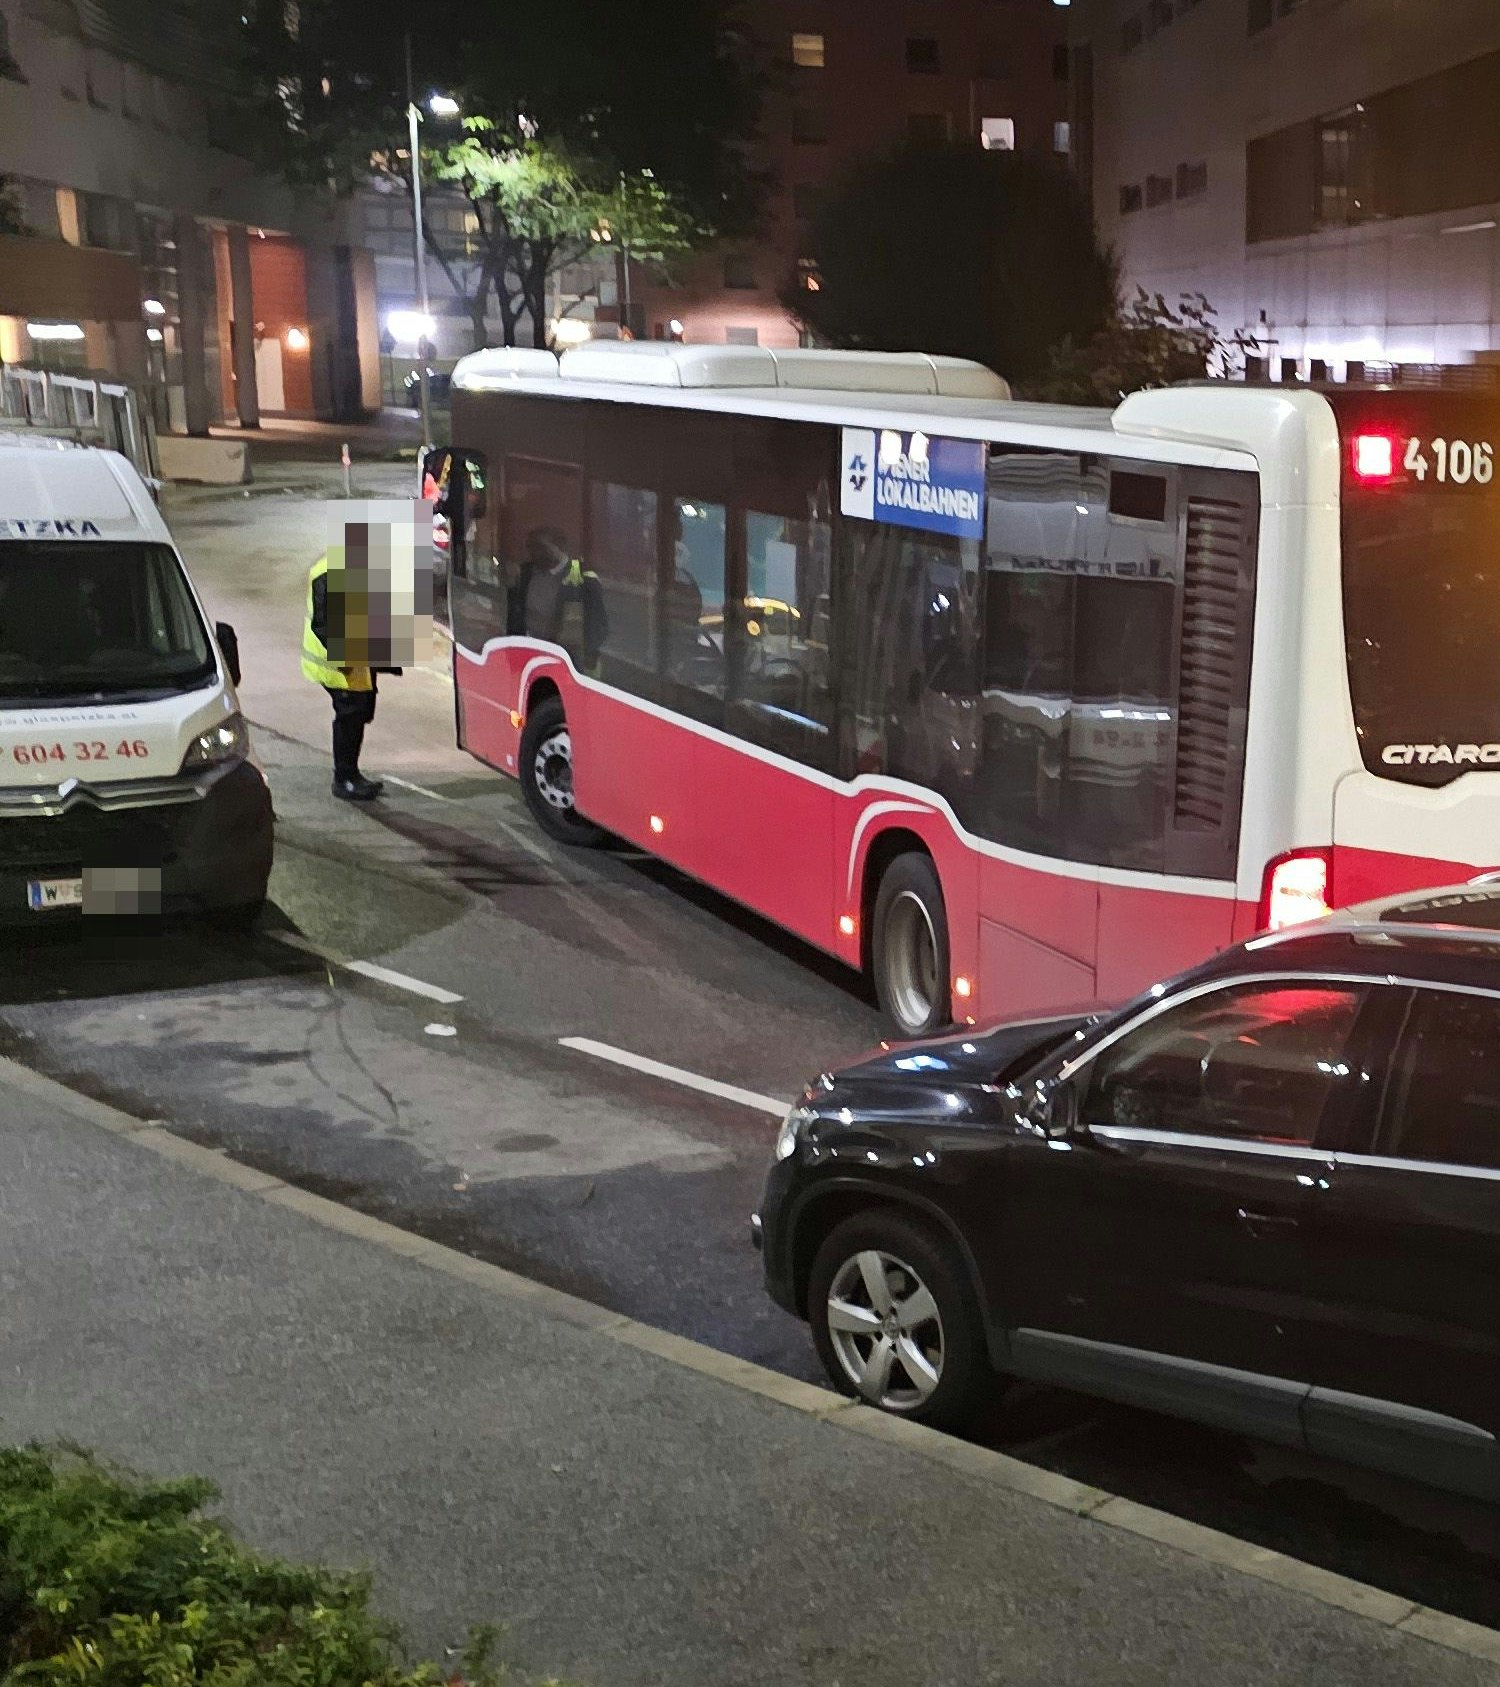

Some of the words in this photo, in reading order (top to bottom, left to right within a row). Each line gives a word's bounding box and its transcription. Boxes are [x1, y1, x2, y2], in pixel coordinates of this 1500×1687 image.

[1404, 437, 1493, 484] 4106
[877, 477, 978, 520] LOKALBAHNEN
[13, 743, 66, 765] 604
[73, 741, 108, 761] 32
[117, 740, 148, 758] 46
